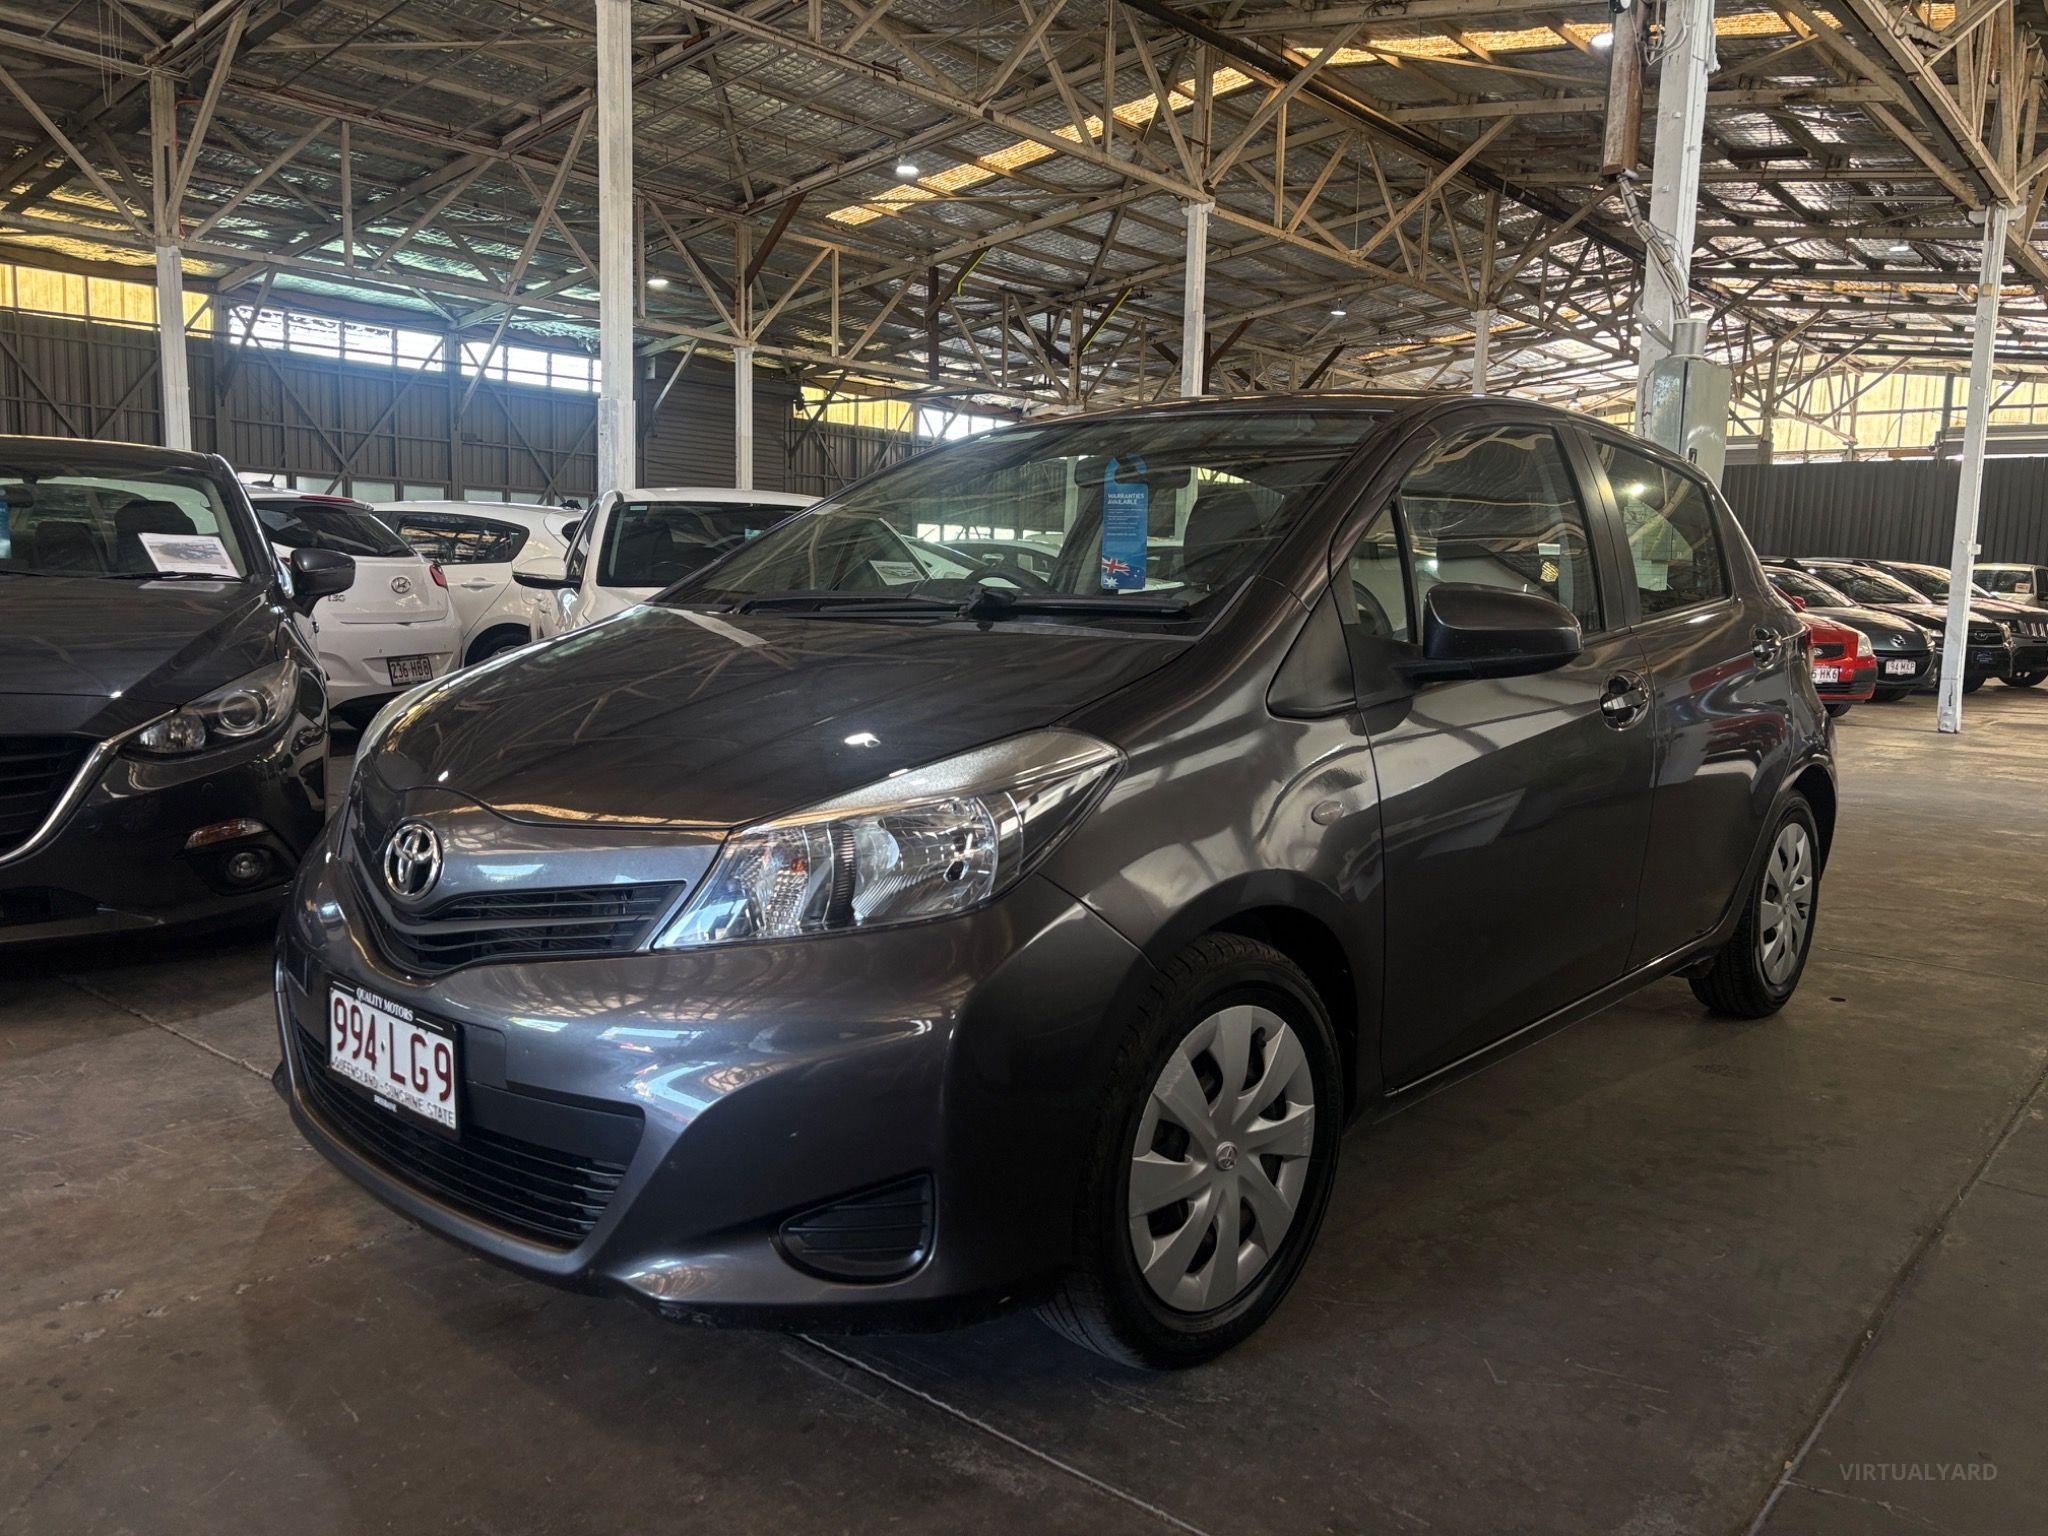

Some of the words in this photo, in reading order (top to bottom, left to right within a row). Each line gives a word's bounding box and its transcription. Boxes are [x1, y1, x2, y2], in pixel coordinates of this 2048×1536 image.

[356, 987, 383, 1010] QUALITY
[383, 1000, 414, 1022] MOTORS
[427, 1102, 454, 1126] STATE
